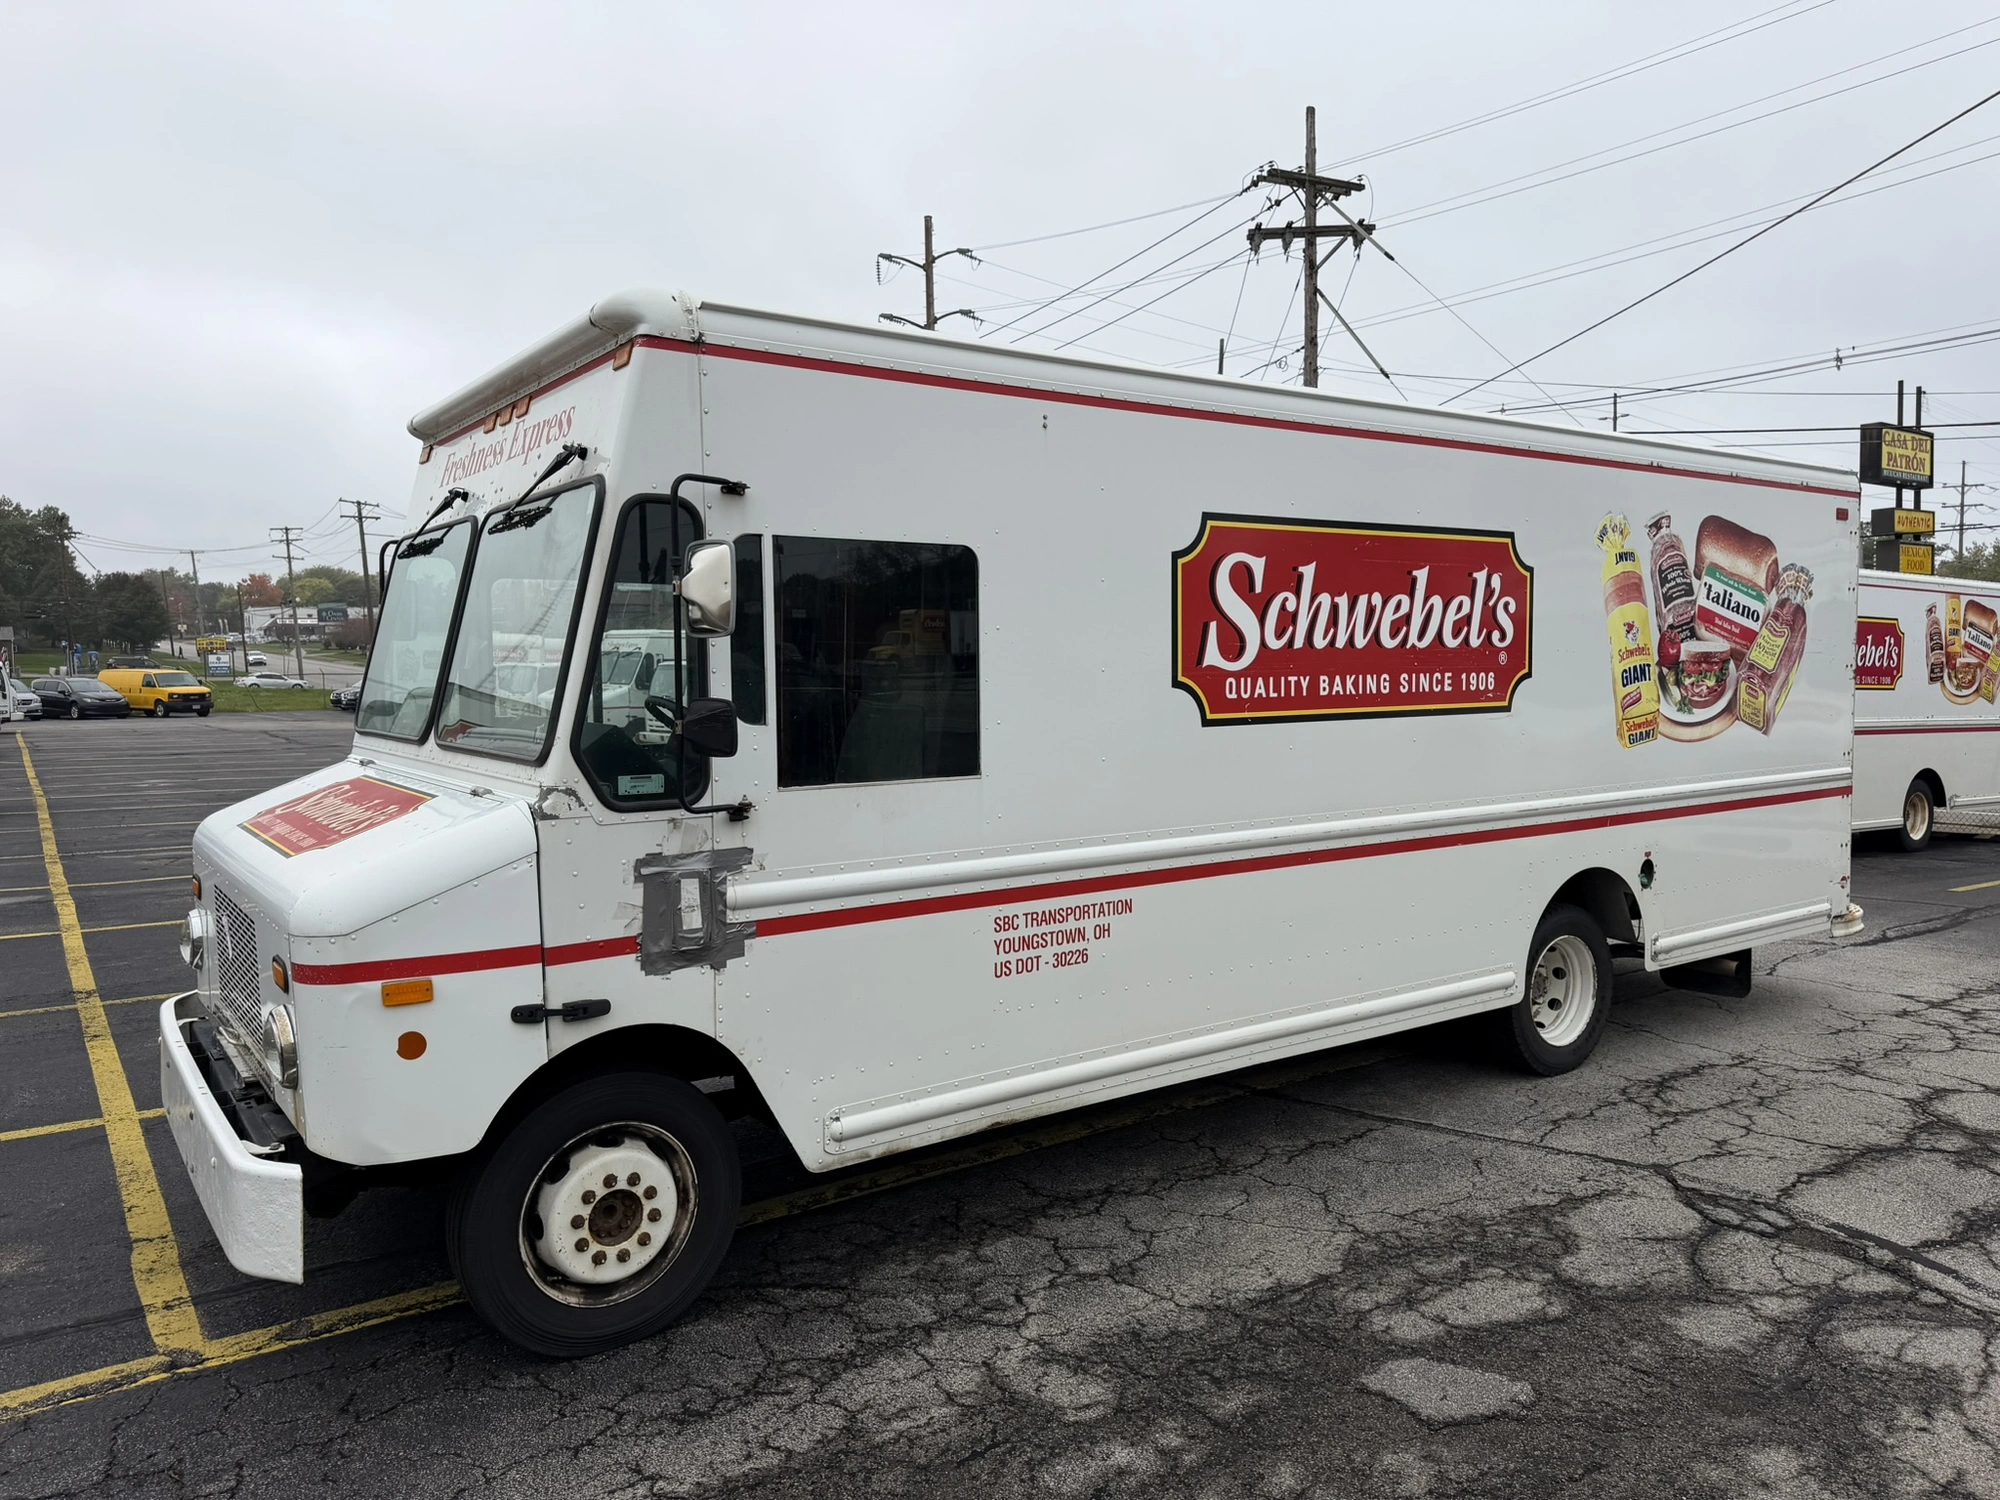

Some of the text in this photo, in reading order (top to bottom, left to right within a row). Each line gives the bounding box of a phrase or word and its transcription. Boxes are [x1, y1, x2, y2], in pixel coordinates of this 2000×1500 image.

[439, 405, 576, 488] Freshness Express
[1883, 431, 1930, 454] CASA DEL
[1886, 451, 1926, 473] PATRÓN
[1897, 515, 1931, 529] AUTHENTIC
[1615, 551, 1636, 565] GIANT
[1901, 546, 1931, 558] MEXICAN
[1907, 560, 1925, 571] FOOD
[1200, 552, 1516, 671] Schwebel's
[1704, 581, 1760, 623] 'taliano
[1618, 643, 1651, 664] Schwebel's
[1856, 634, 1899, 668] ebel's
[1225, 672, 1496, 699] QUALITY BAKING SINCE 1906
[1621, 663, 1652, 688] GIANT
[1628, 727, 1656, 745] GIANT
[993, 898, 1133, 933] SBC TRANSPORTATION
[993, 922, 1111, 956] YOUNGSTOWN, OH
[994, 960, 1012, 979] US
[1015, 955, 1042, 975] DOT
[1052, 948, 1089, 968] 30226
